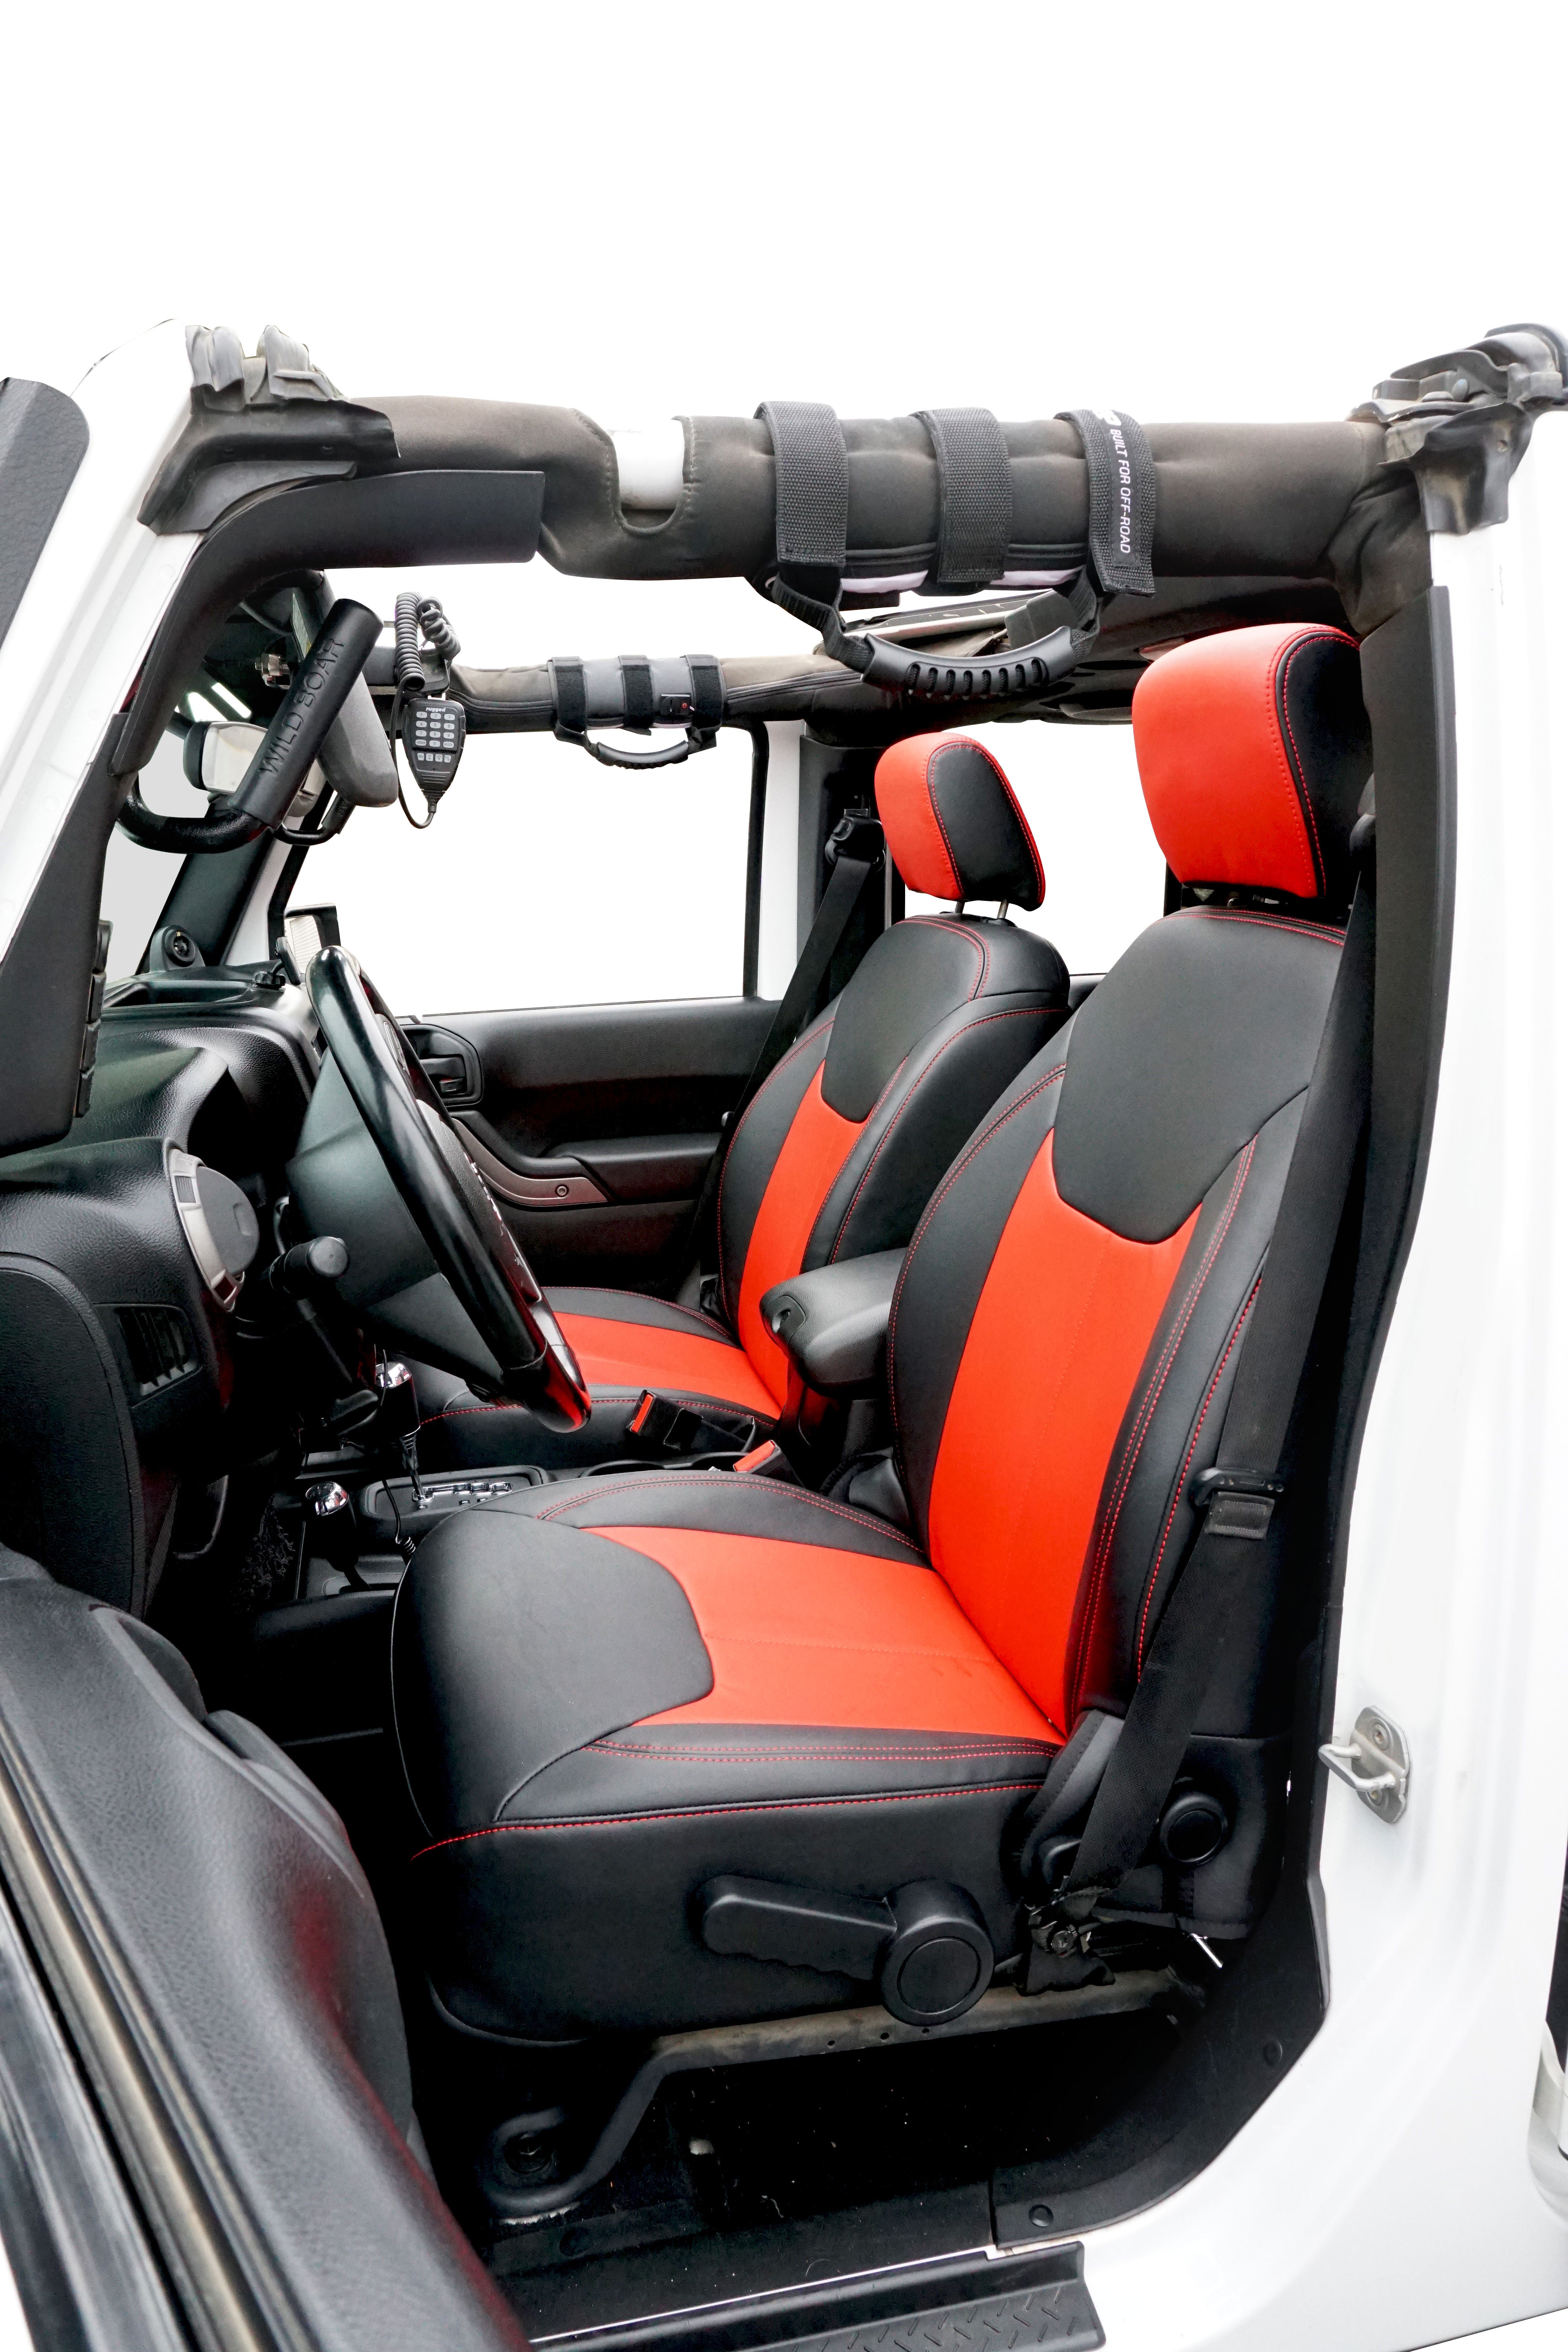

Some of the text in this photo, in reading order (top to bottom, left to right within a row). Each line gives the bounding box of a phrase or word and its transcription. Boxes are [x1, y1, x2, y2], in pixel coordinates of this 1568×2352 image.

[1110, 428, 1131, 554] BUILT FOR OFF-ROAD
[258, 637, 345, 773] WILD BOAR
